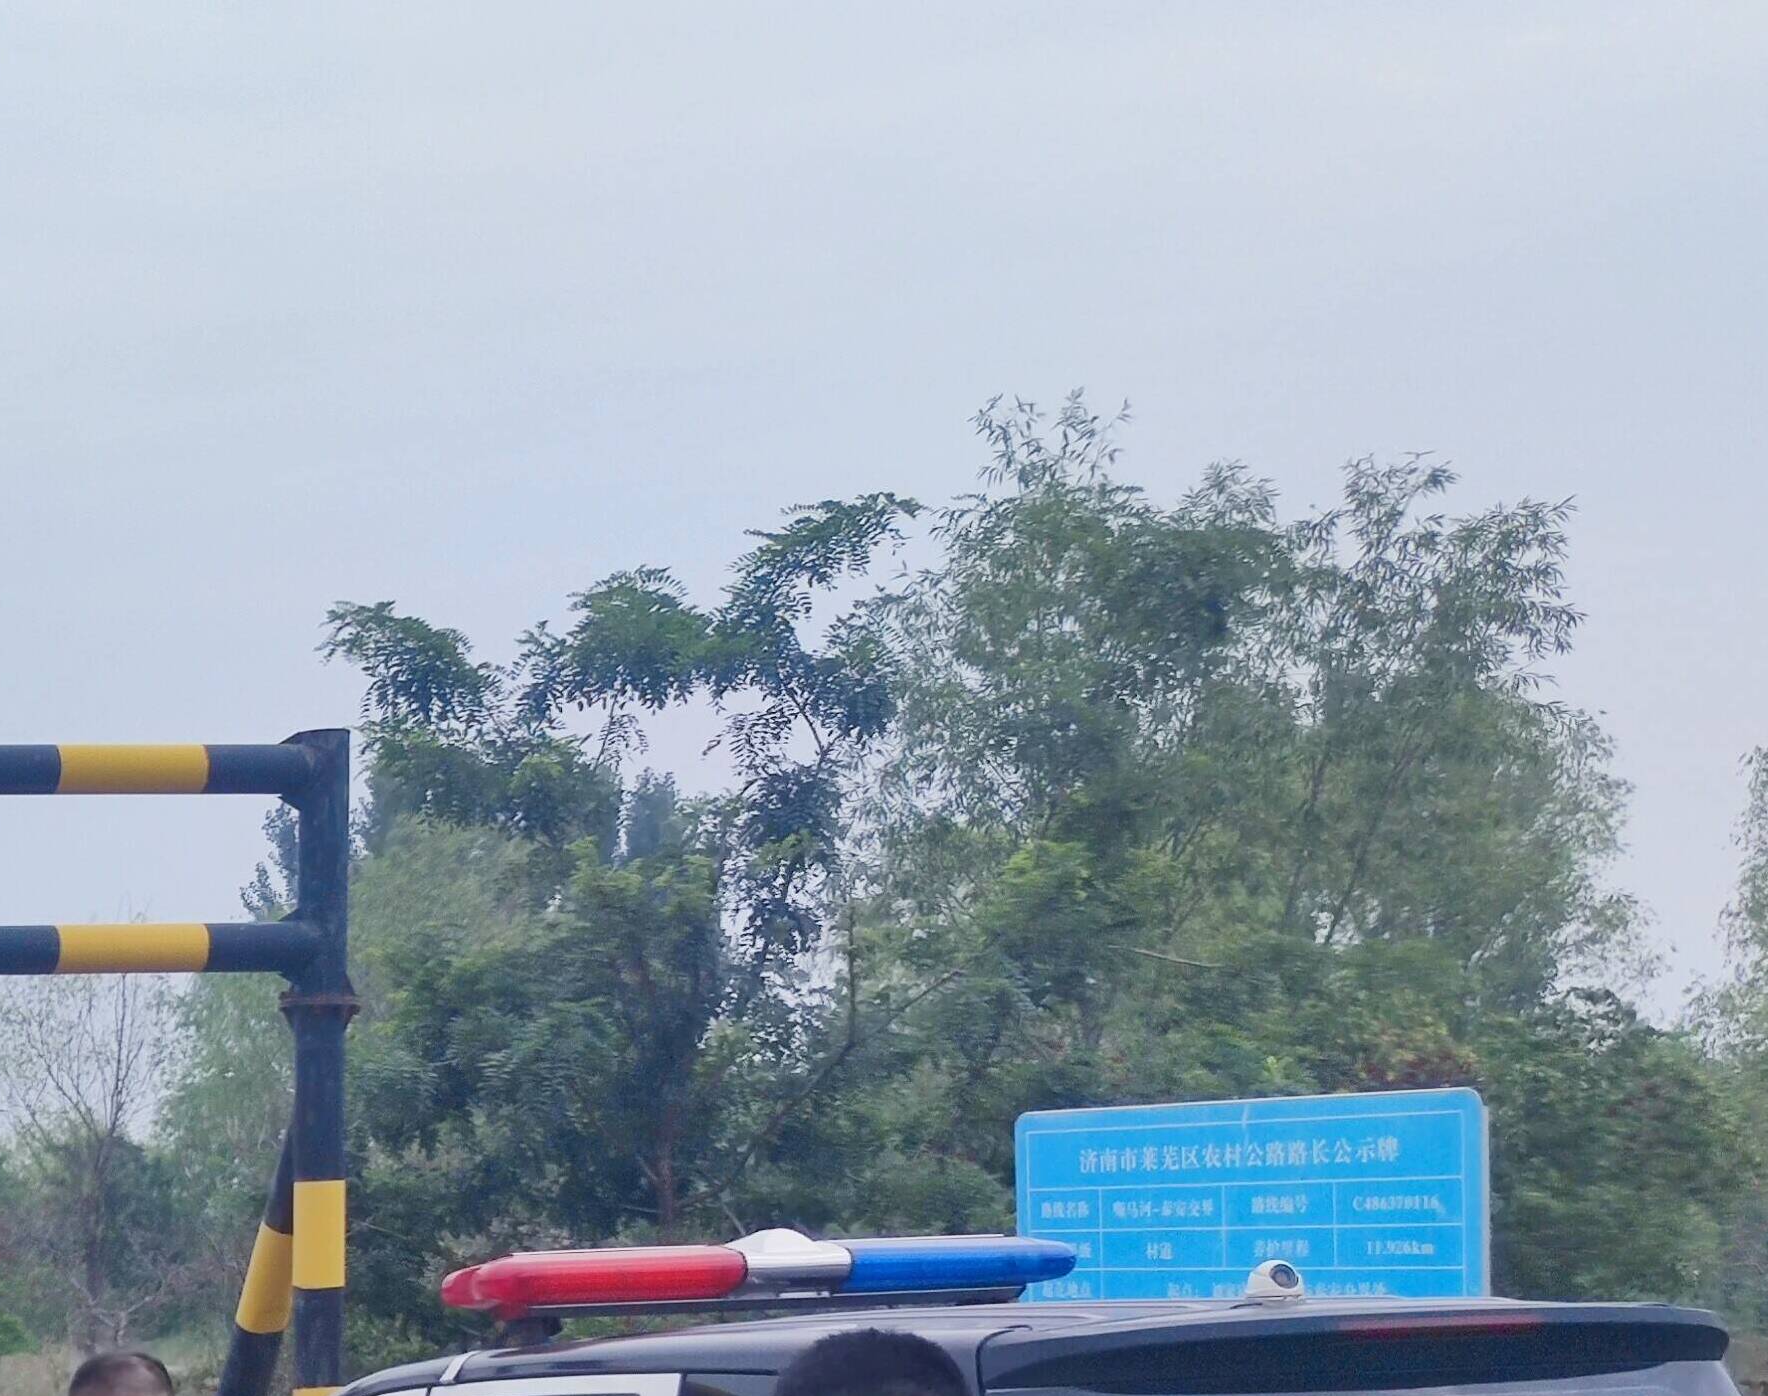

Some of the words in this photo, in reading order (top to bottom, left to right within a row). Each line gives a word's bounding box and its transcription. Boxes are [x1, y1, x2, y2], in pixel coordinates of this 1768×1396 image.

[1078, 1136, 1400, 1173] 济南市莱芜区农村公路路长公示牌
